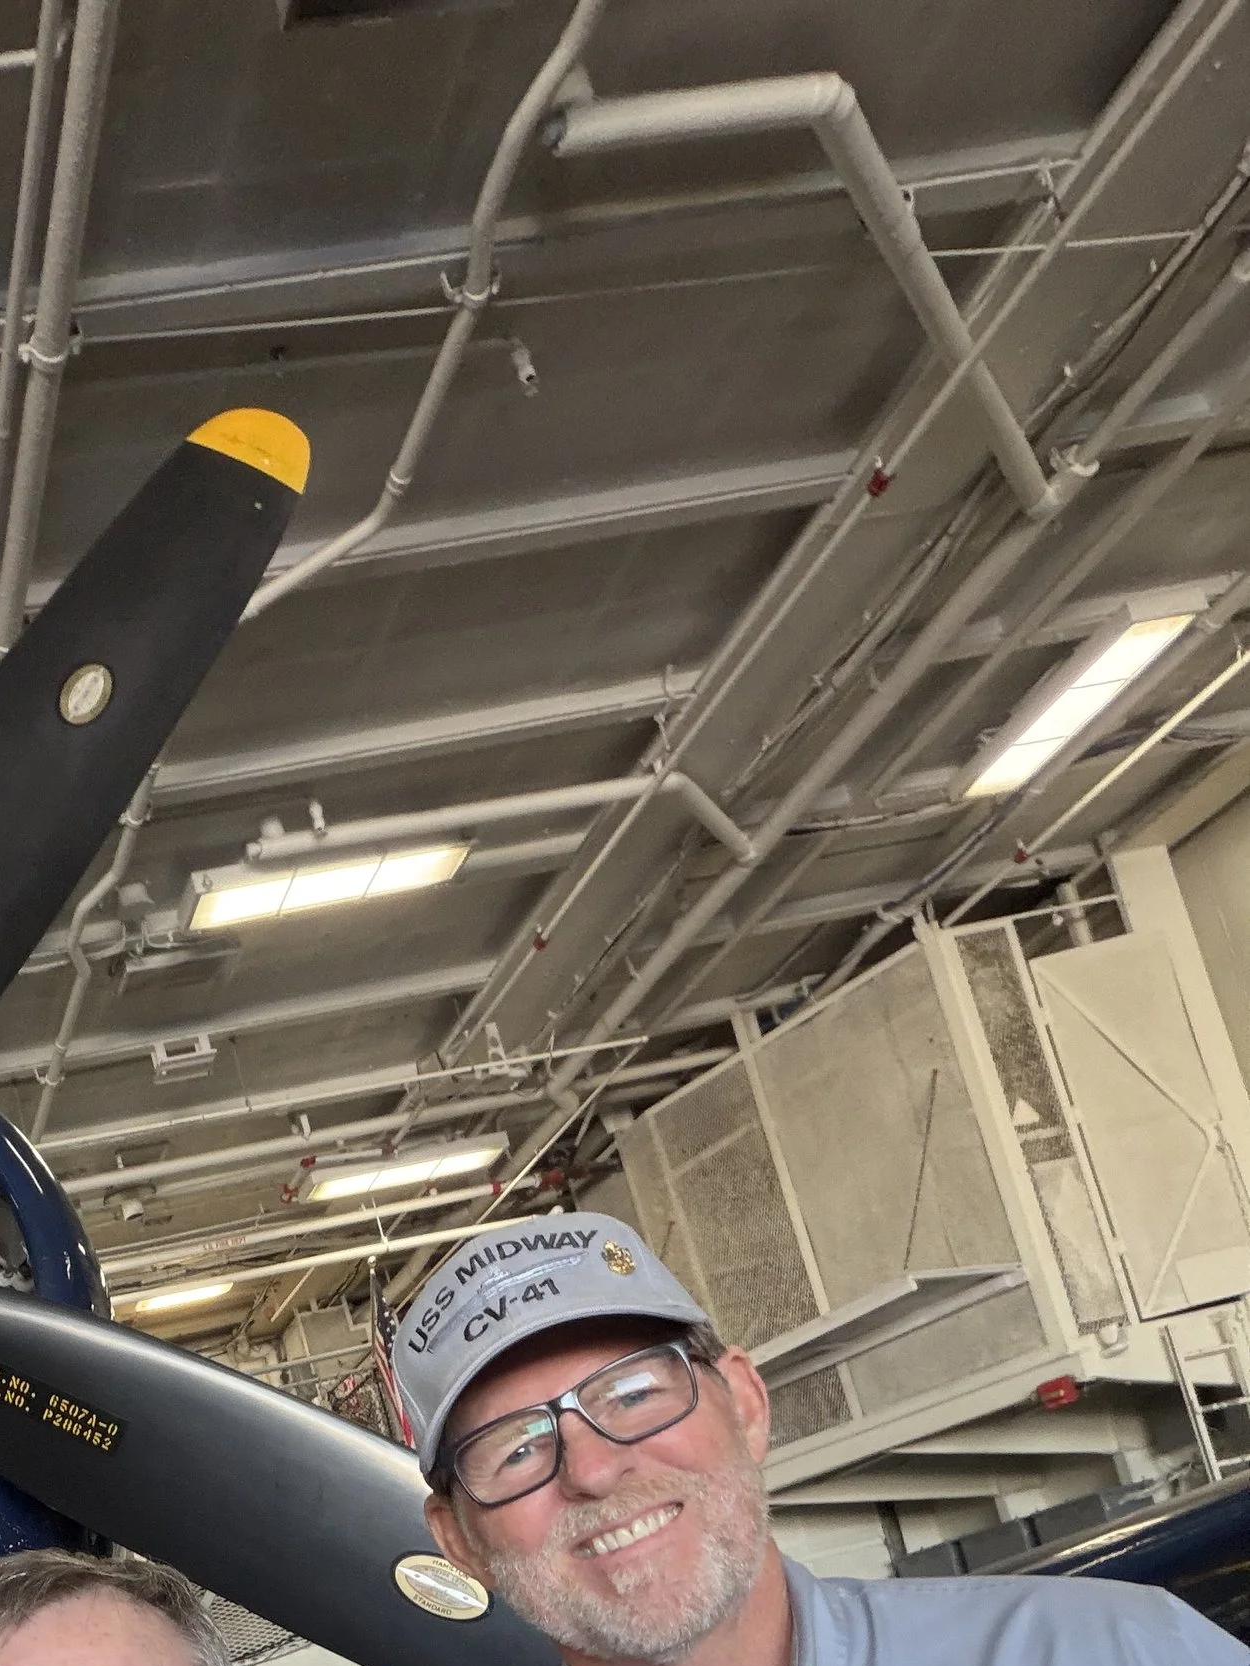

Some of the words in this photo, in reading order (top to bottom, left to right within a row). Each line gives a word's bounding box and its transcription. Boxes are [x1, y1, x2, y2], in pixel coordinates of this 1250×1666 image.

[408, 1285, 455, 1353] USS
[455, 1229, 598, 1286] MIDWAY
[463, 1277, 561, 1342] CV-41
[49, 1394, 119, 1436] 6507A-0
[412, 1594, 453, 1616] STANDARD
